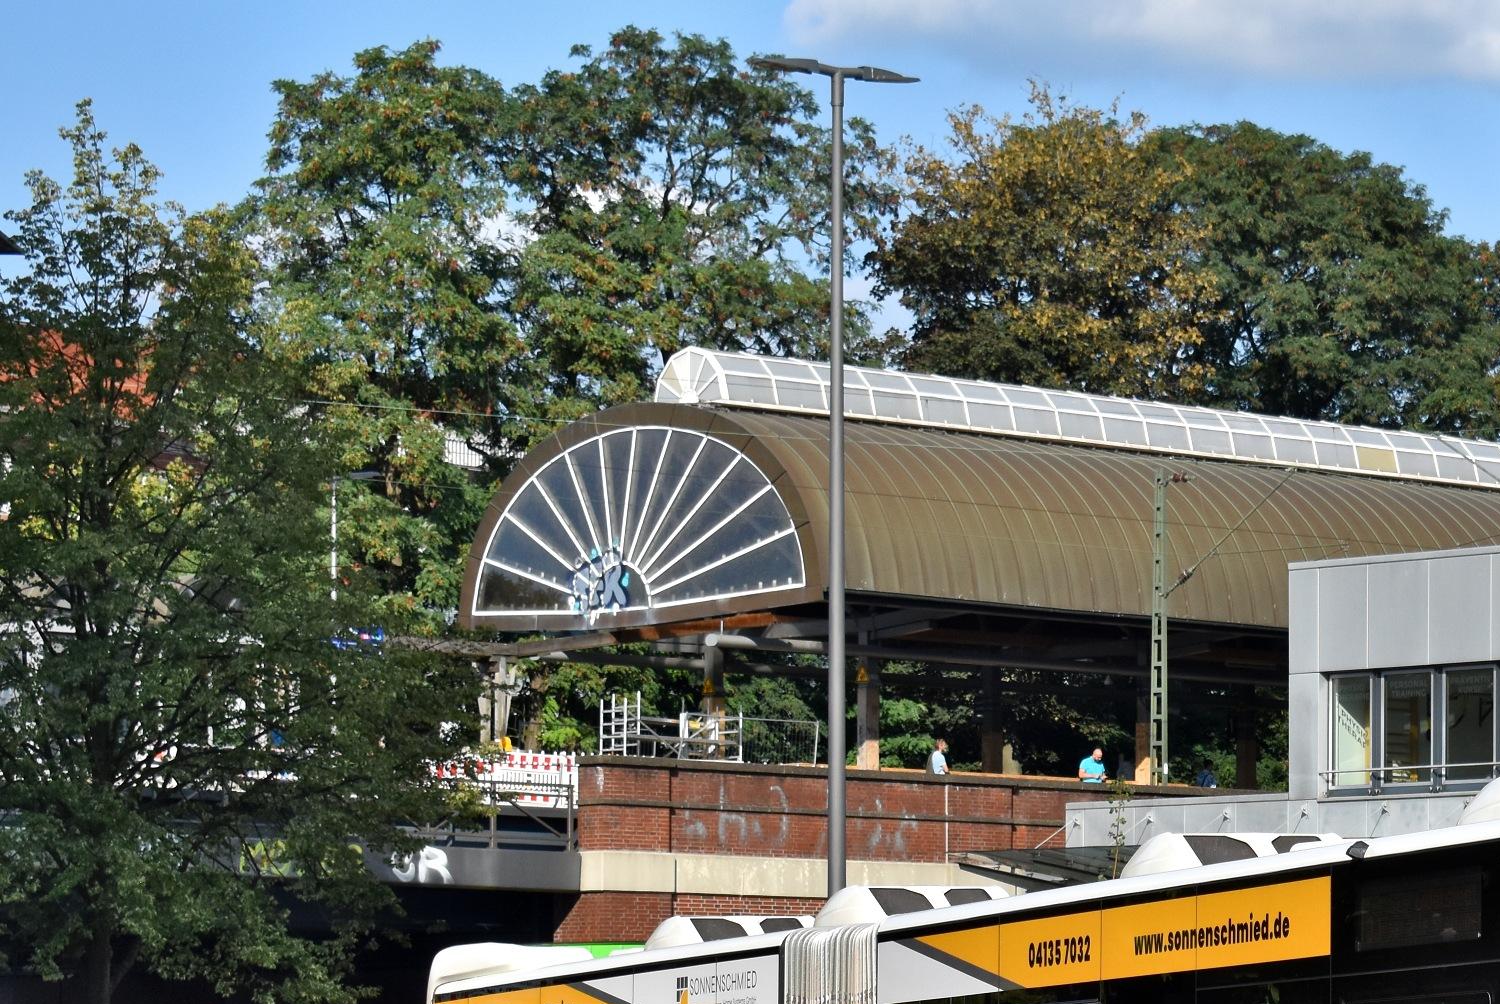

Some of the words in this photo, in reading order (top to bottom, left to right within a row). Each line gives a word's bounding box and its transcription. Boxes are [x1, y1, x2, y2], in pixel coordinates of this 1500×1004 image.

[1028, 939, 1062, 969] 04135
[1064, 935, 1091, 965] 7032
[1134, 911, 1290, 956] www.sonnenschmied.de
[689, 970, 758, 996] SONNENSCHMIED
